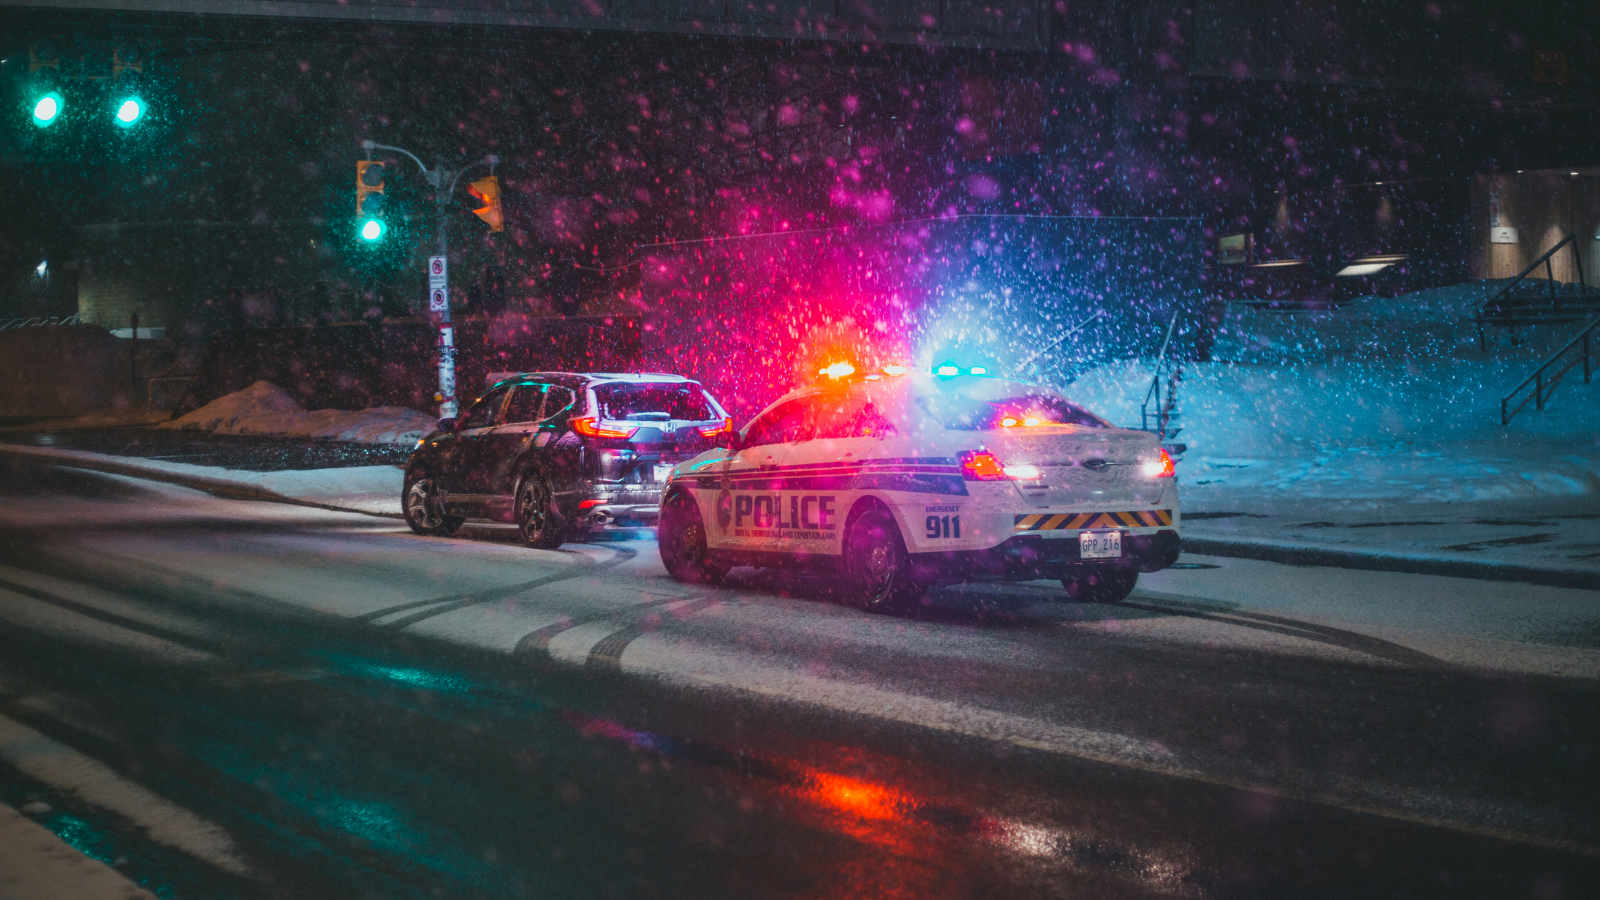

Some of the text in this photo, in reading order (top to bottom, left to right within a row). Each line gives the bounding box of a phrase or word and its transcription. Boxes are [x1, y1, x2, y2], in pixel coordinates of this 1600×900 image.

[735, 495, 836, 530] POLICE
[926, 505, 960, 513] EMERGENCY
[926, 515, 960, 539] 911
[735, 529, 836, 540] ROYAL NEWFOUNDLAND CONSTABULARY
[1083, 538, 1120, 551] GPP 216
